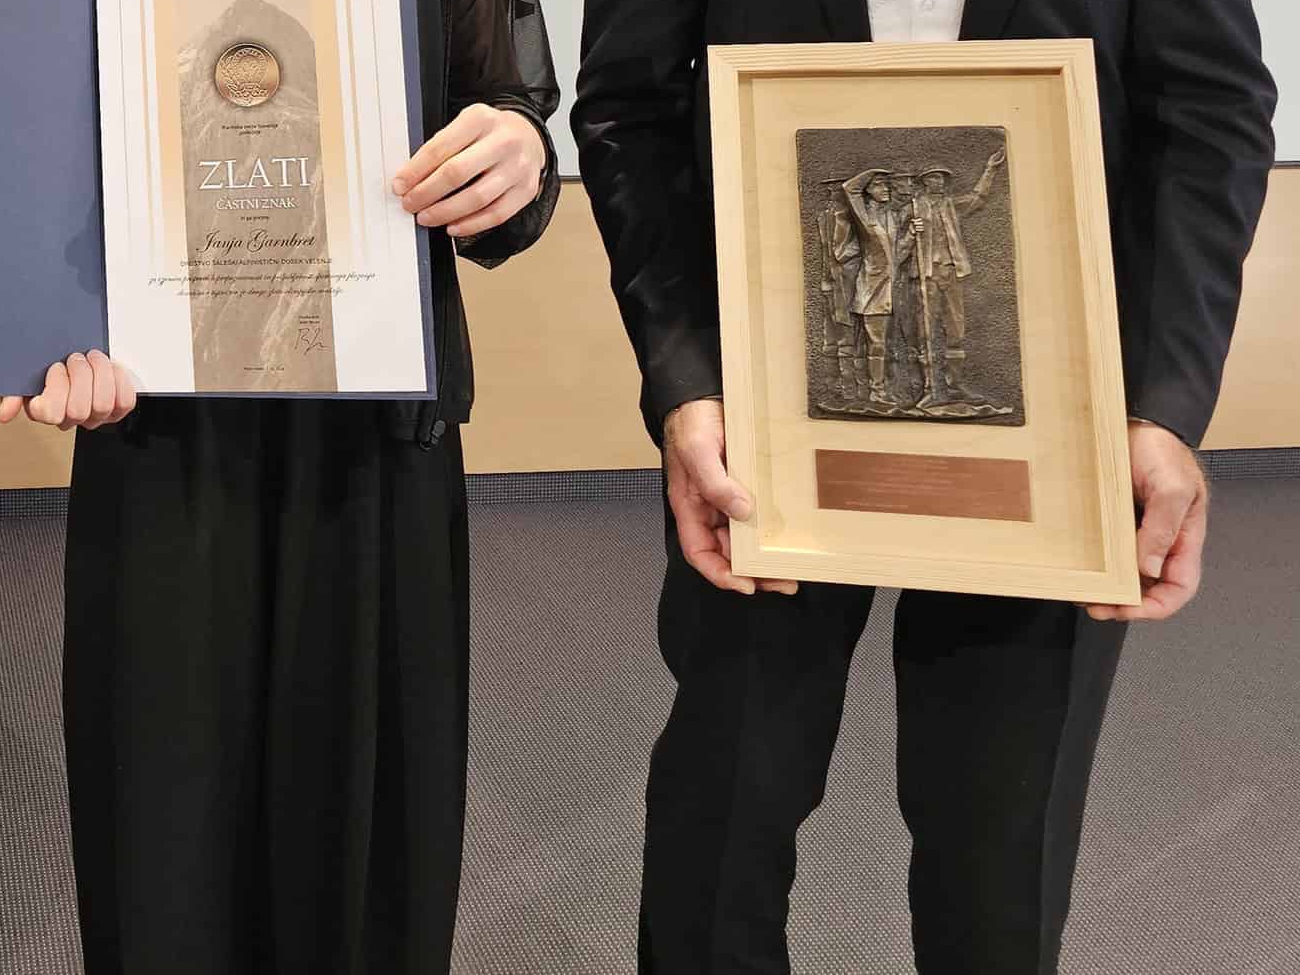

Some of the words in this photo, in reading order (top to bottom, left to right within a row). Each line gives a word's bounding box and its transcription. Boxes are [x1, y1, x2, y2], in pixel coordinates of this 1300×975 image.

[197, 156, 311, 190] ZLATI
[260, 196, 297, 210] ZNAK
[196, 230, 243, 256] Janja
[246, 228, 316, 254] Garnbret
